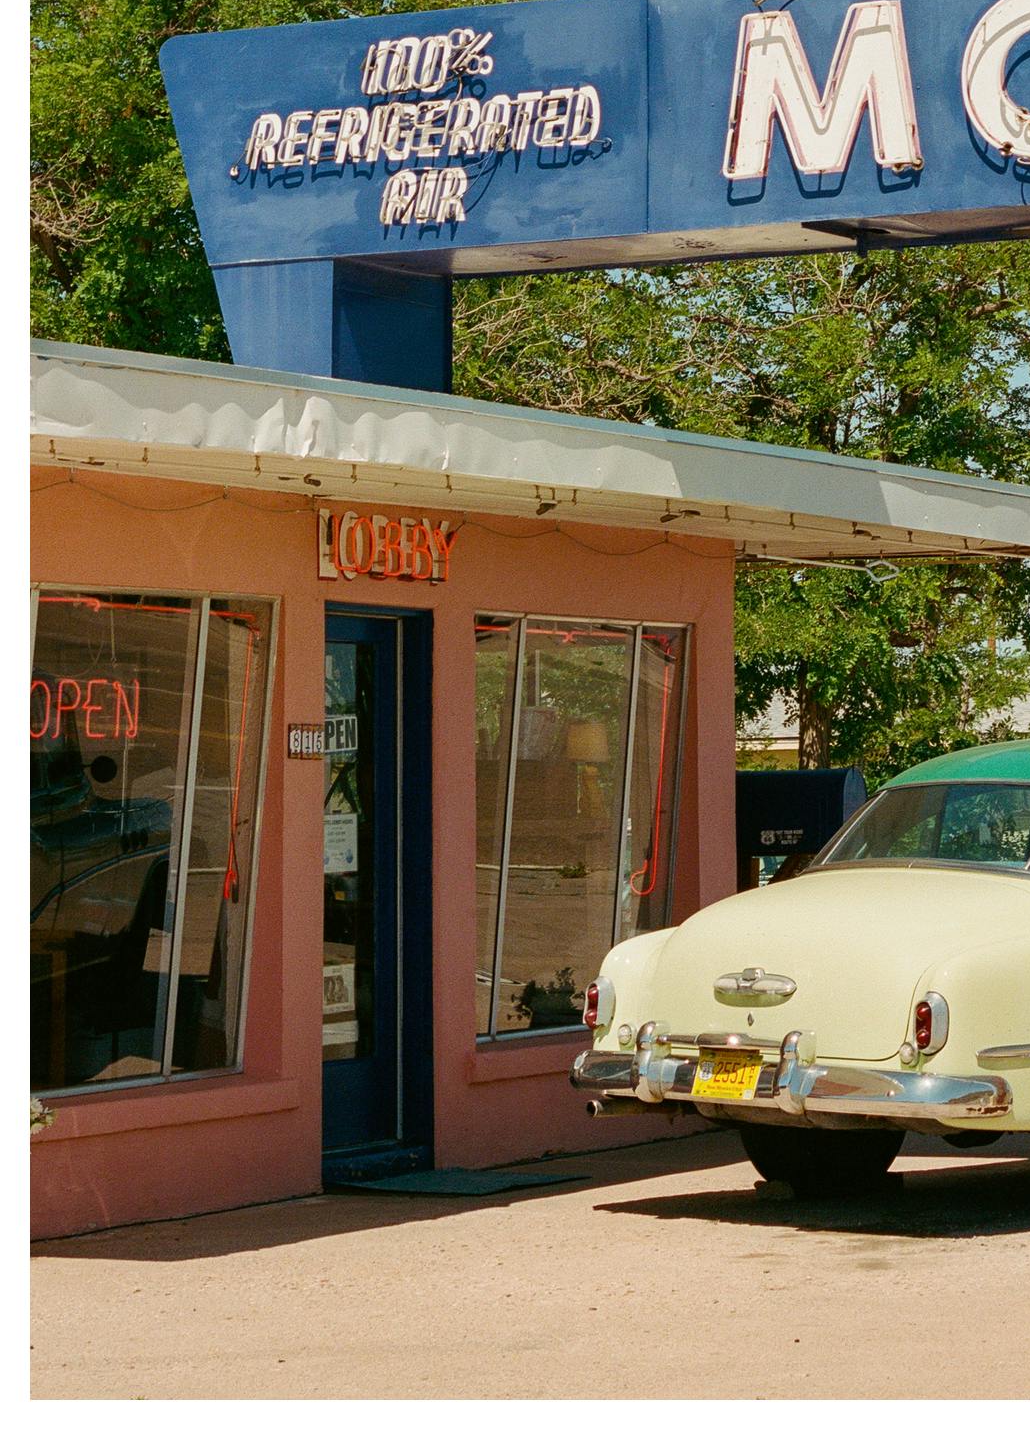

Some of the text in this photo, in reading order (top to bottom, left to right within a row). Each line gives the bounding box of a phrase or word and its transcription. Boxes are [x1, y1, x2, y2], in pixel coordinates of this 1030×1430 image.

[360, 27, 495, 95] 100%
[244, 84, 602, 170] REFRIGERATED
[379, 166, 467, 225] AIR
[318, 508, 460, 584] LOBBY
[30, 679, 140, 739] OPEN
[325, 720, 356, 750] PEN
[293, 732, 322, 749] 815
[714, 1061, 747, 1084] 2551
